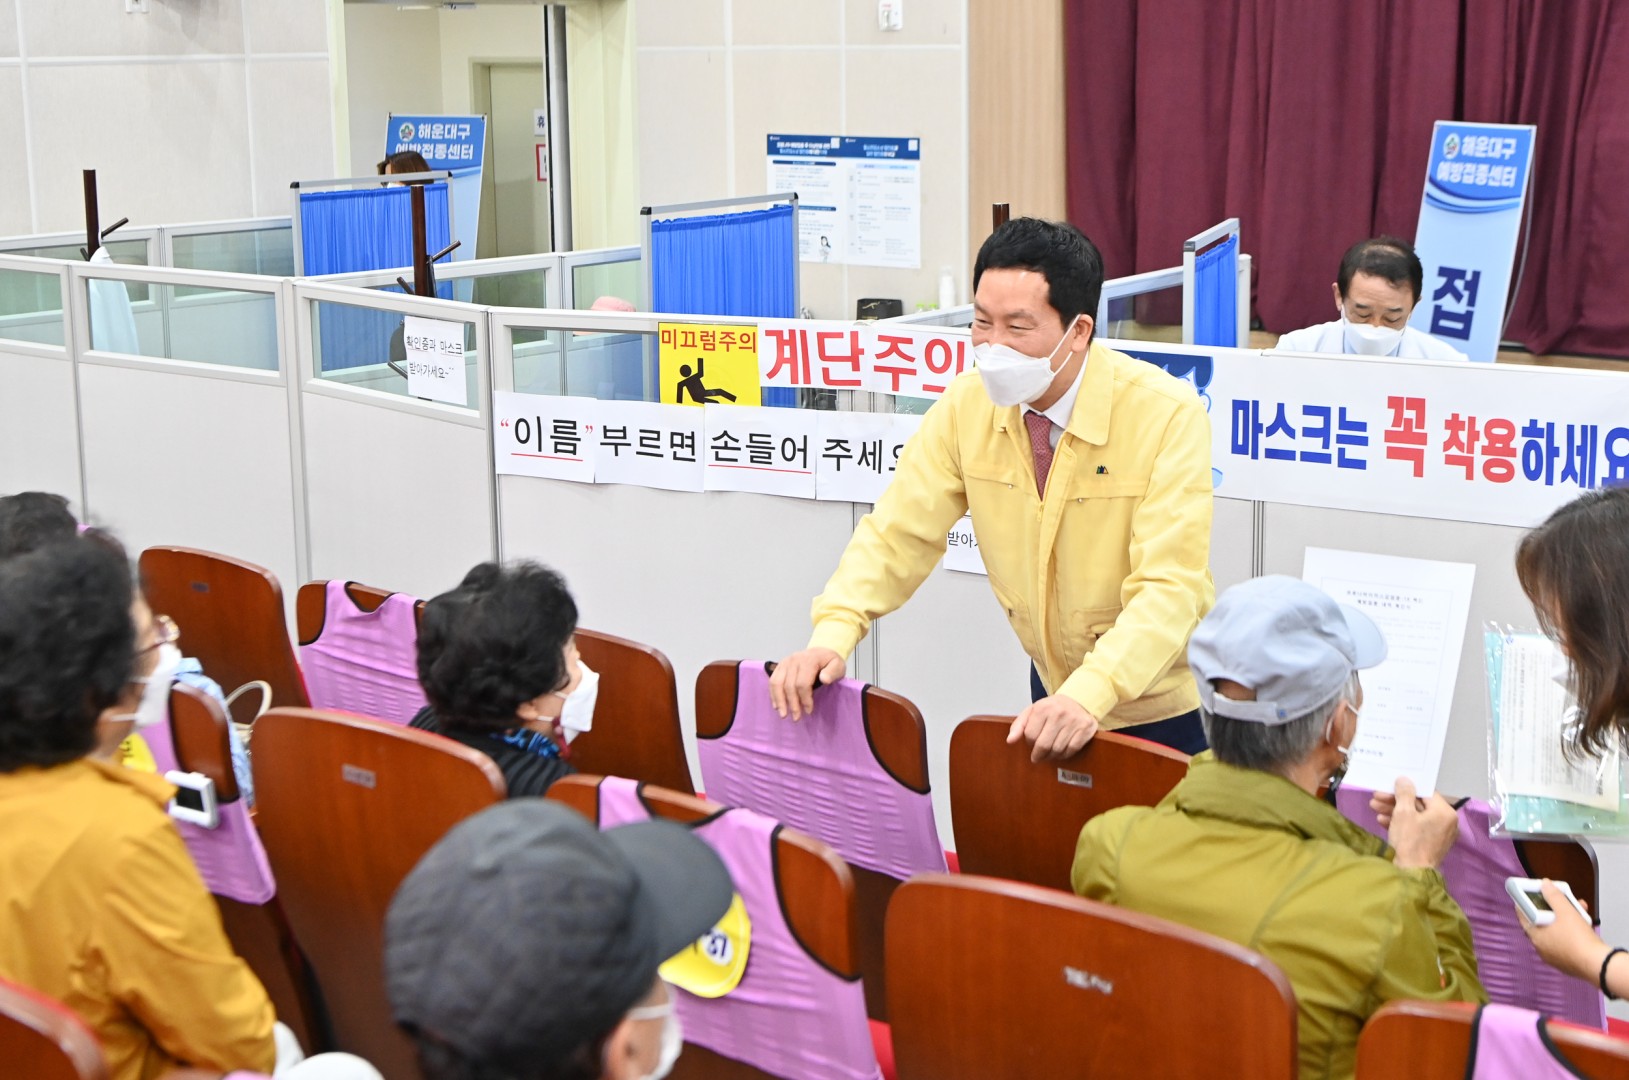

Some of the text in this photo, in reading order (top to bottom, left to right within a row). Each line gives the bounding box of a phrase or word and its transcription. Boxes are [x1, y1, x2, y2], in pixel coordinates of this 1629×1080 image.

[418, 122, 471, 141] 해운대구
[1461, 135, 1517, 160] 해운대구
[1436, 161, 1518, 188] 예방접종센터
[1429, 265, 1482, 341] 접
[406, 335, 463, 354] 확인증과 마스크
[661, 328, 757, 353] 미끄럼주의
[600, 425, 697, 463] 부르면
[710, 429, 808, 469] 손들어
[1231, 399, 1369, 470] 마스크는
[1384, 395, 1428, 478] 꼭
[947, 531, 978, 548] 받아
